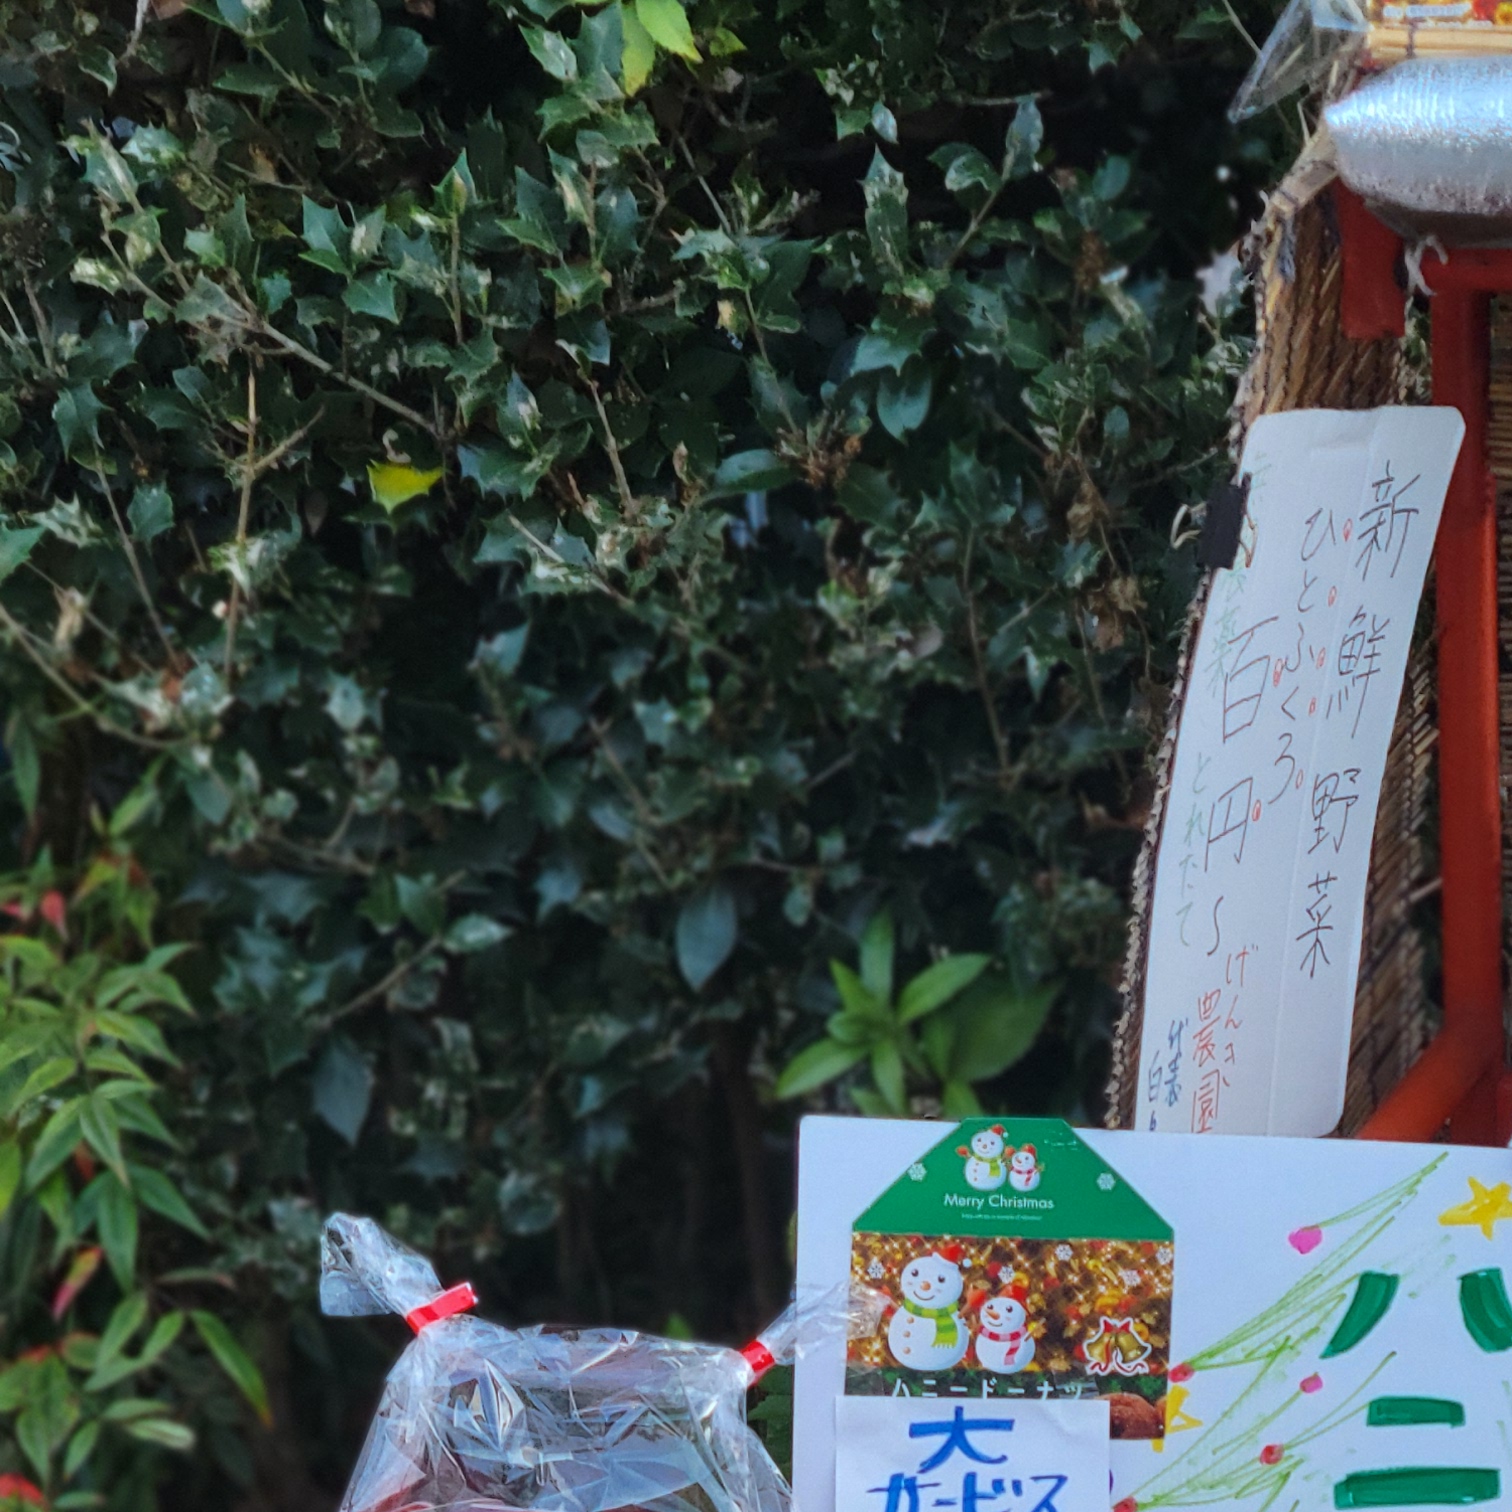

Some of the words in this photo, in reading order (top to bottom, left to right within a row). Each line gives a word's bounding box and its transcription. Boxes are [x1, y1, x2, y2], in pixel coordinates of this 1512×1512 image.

[1268, 507, 1339, 804] ひとふくろ
[1297, 461, 1420, 980] 新鮮野菜
[943, 1192, 985, 1211] Merry
[988, 1194, 1055, 1210] Christmas
[891, 1377, 1084, 1400] ハニードーナツ
[908, 1405, 1016, 1474] 大
